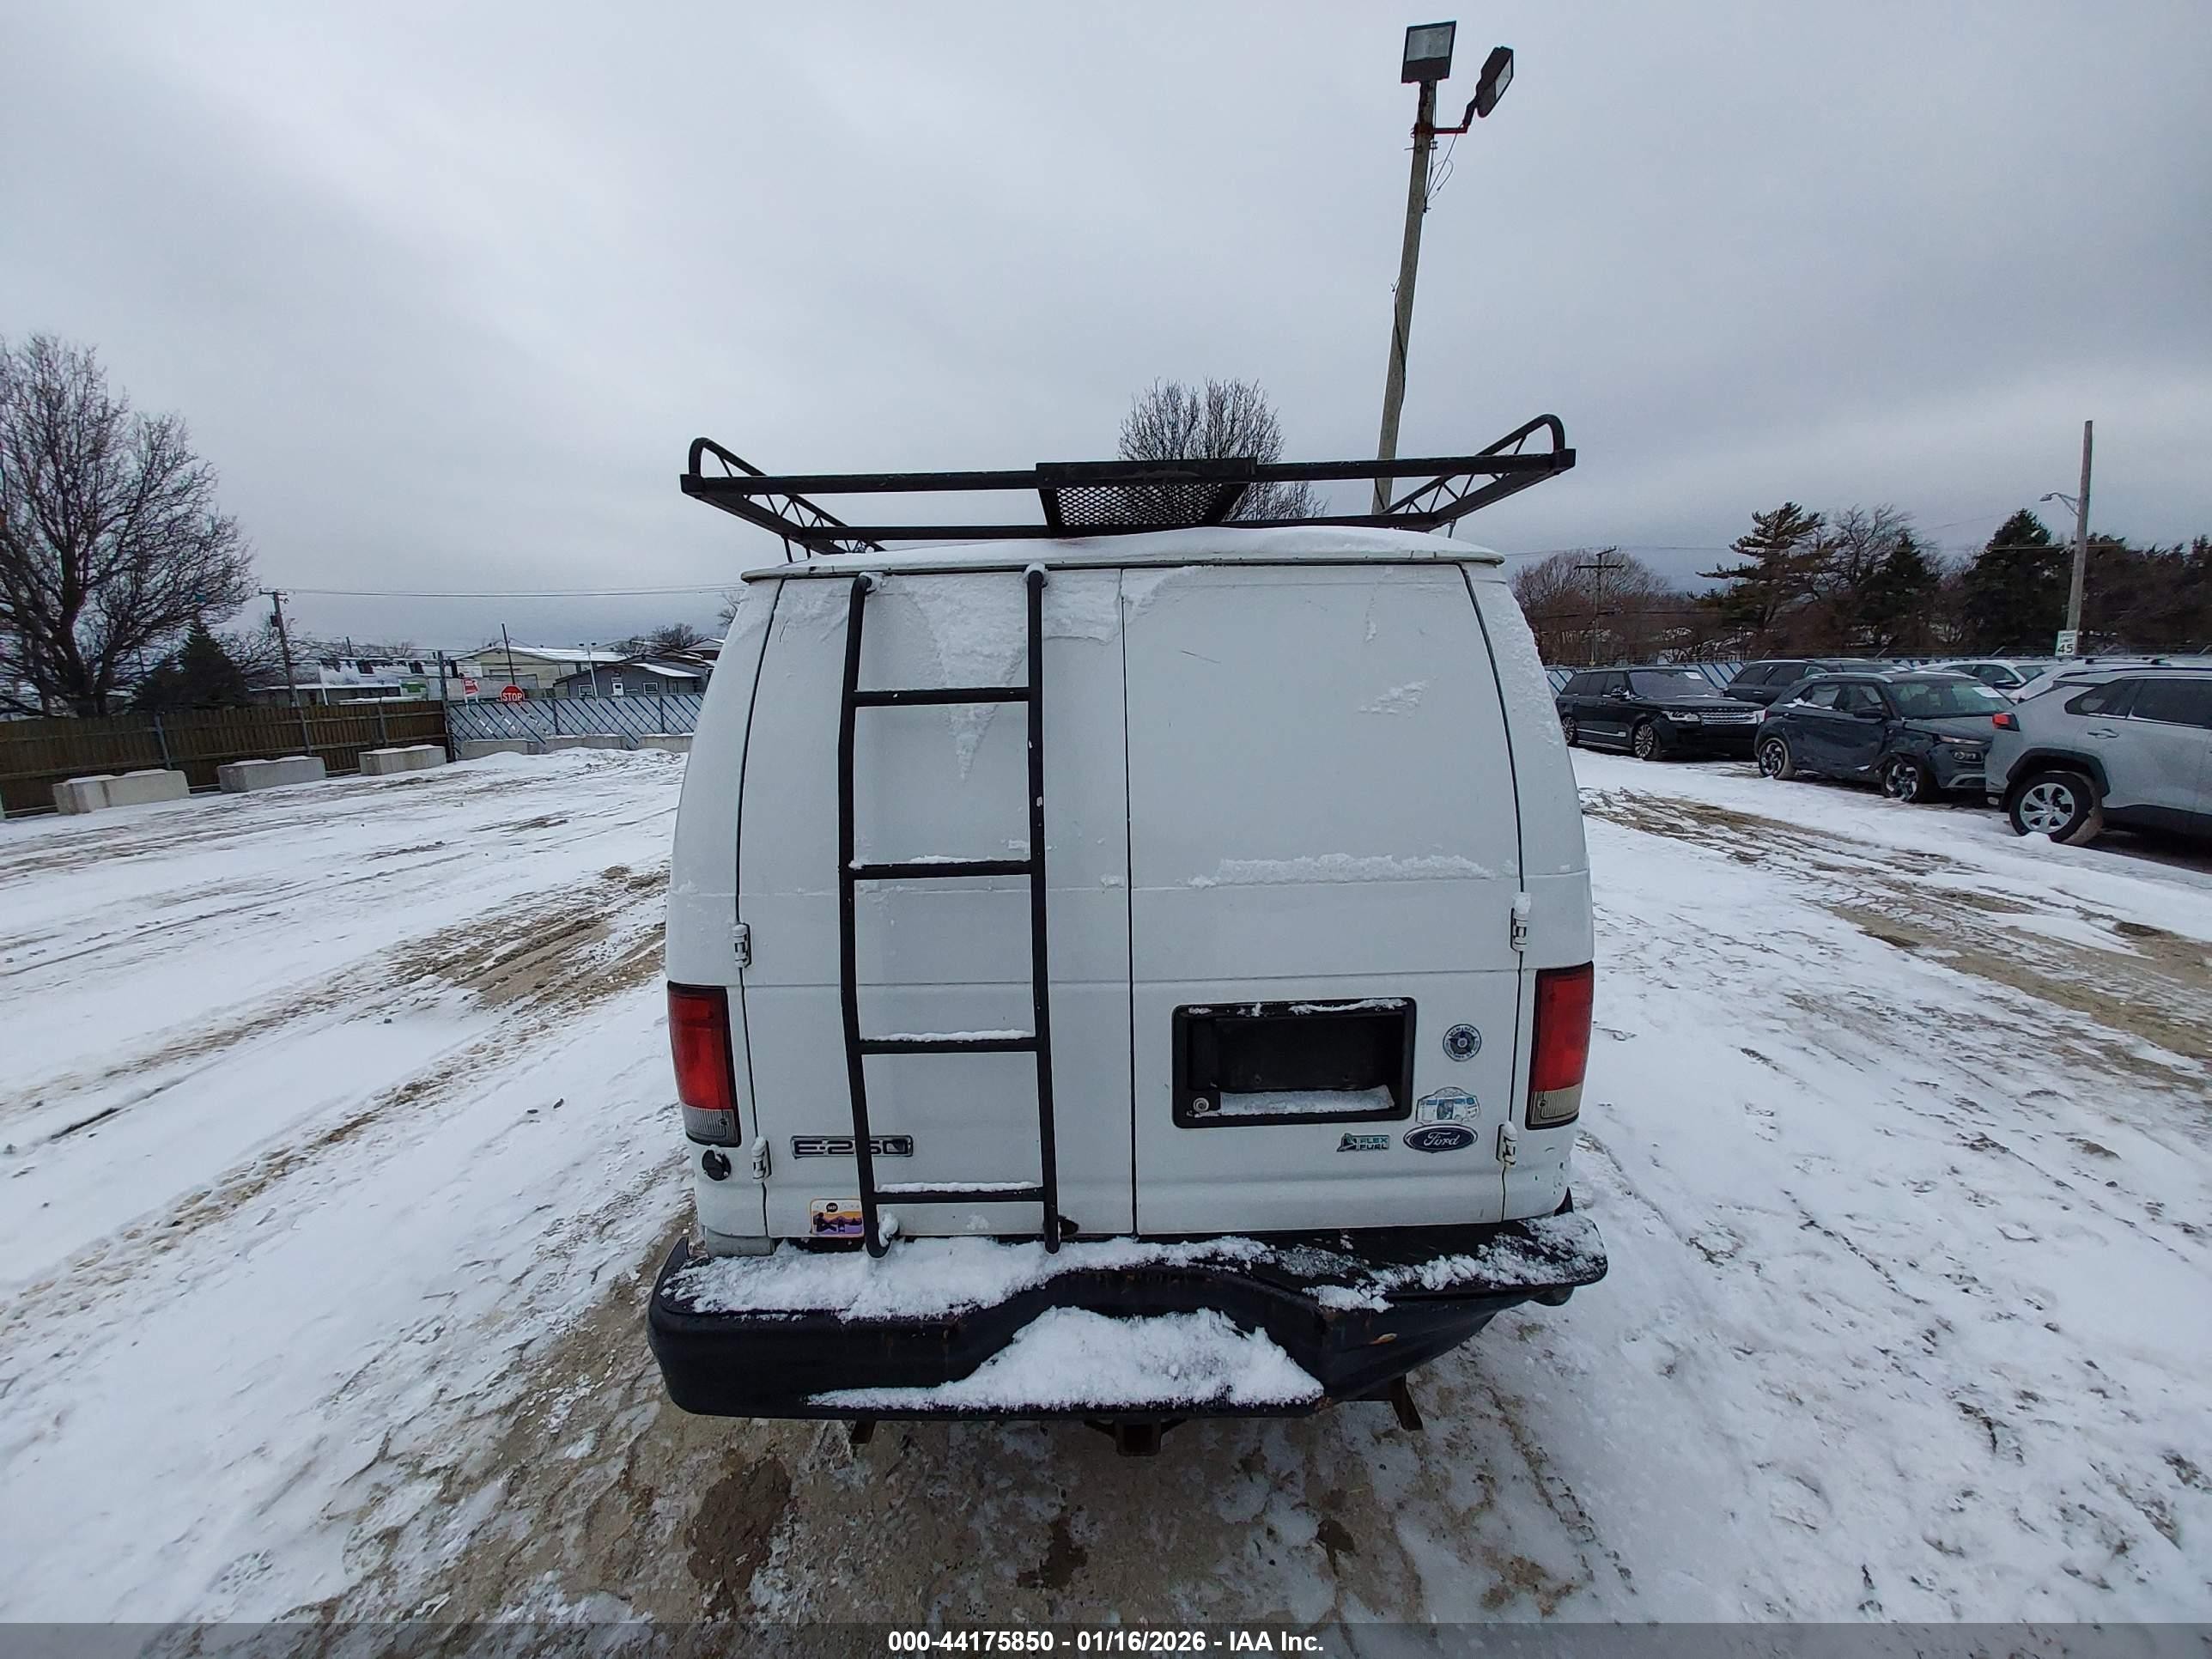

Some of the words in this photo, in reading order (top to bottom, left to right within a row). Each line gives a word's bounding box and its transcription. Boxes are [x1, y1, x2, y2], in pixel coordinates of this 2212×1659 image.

[2057, 643, 2075, 653] 45
[501, 692, 523, 702] STOP
[1423, 1132, 1460, 1146] Ford
